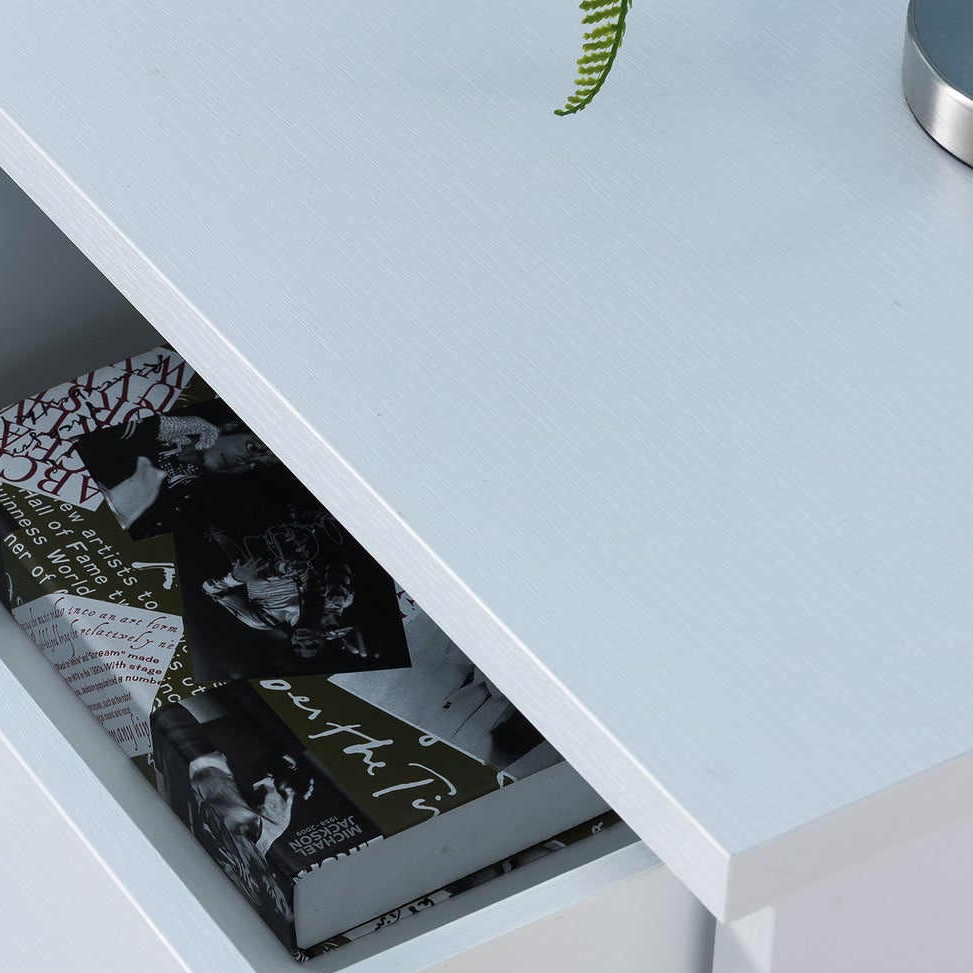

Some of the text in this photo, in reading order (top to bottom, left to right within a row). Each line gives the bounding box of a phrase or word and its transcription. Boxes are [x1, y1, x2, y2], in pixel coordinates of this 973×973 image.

[48, 519, 74, 537] of
[66, 540, 109, 586] Fame
[82, 526, 138, 587] artists
[137, 590, 158, 610] to
[31, 565, 57, 585] of
[46, 547, 97, 598] World
[68, 606, 96, 617] into
[99, 612, 116, 621] an
[119, 616, 143, 626] art
[146, 616, 178, 633] form
[81, 622, 154, 649] relatively
[104, 661, 126, 671] With
[129, 663, 163, 675] stage
[127, 652, 160, 665] made
[308, 722, 394, 776] the
[288, 815, 355, 851] JACKSON
[301, 824, 363, 857] MICHAEL
